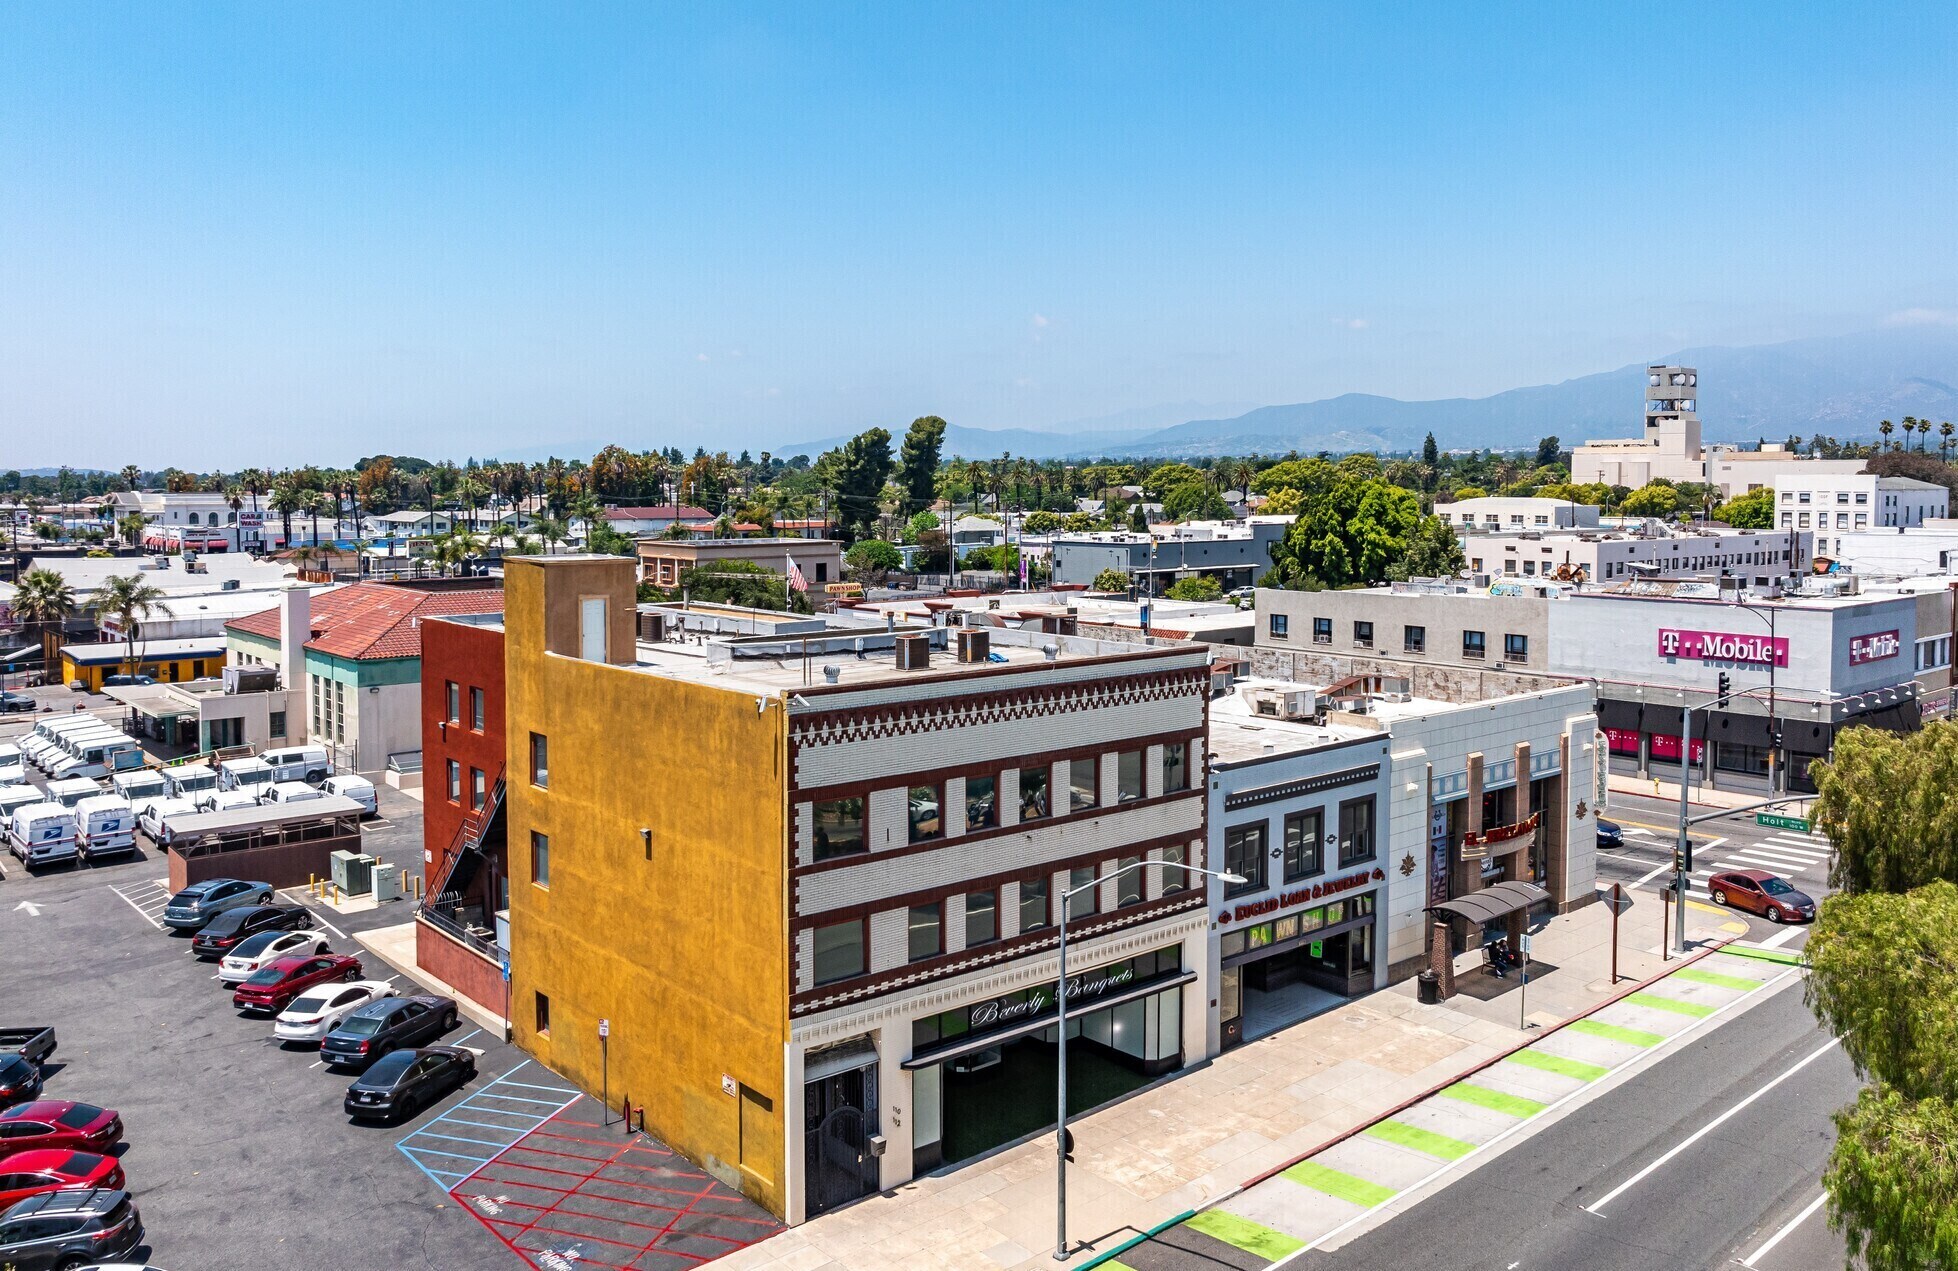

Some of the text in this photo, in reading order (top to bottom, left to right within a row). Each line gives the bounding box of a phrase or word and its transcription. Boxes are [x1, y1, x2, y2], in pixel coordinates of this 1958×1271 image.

[1762, 816, 1784, 826] Holt
[1235, 898, 1279, 921] EUCLID
[1311, 884, 1322, 899] &
[1323, 871, 1370, 896] JEWELRY
[971, 968, 1133, 1027] Beverly Banquets
